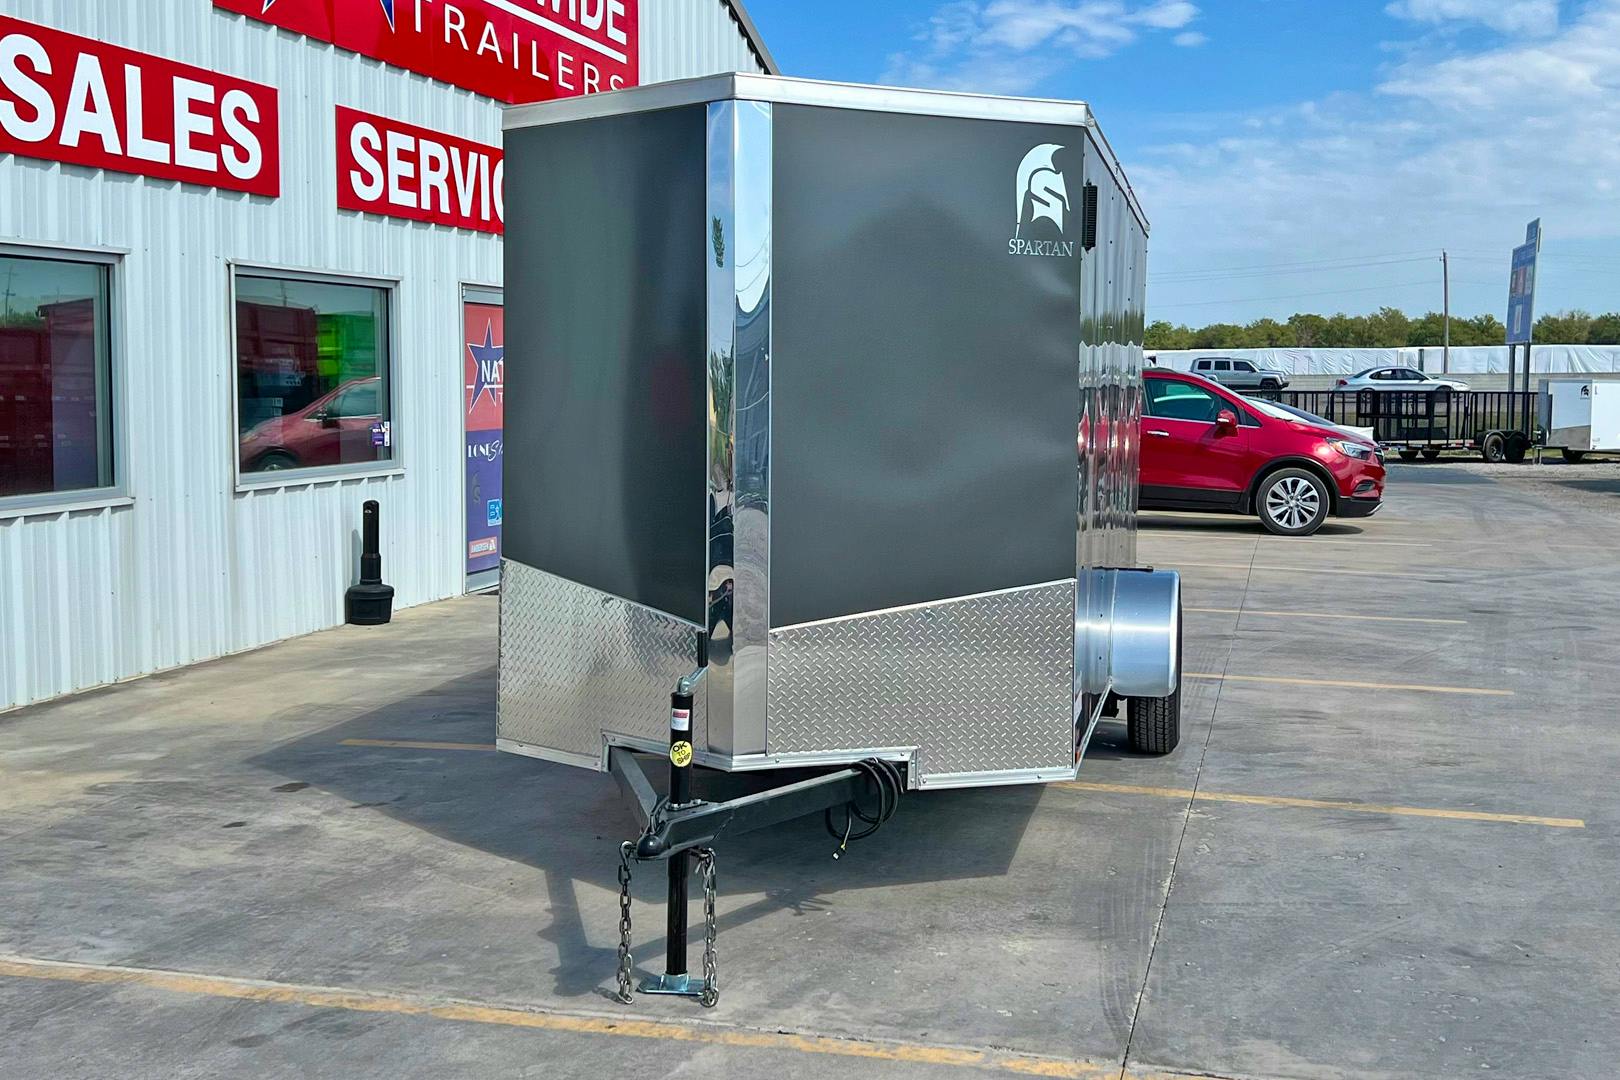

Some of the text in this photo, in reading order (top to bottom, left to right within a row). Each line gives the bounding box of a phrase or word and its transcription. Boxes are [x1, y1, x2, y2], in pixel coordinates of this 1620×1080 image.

[0, 33, 262, 180] SALES
[1008, 238, 1074, 257] SPARTAN
[672, 741, 688, 752] OK
